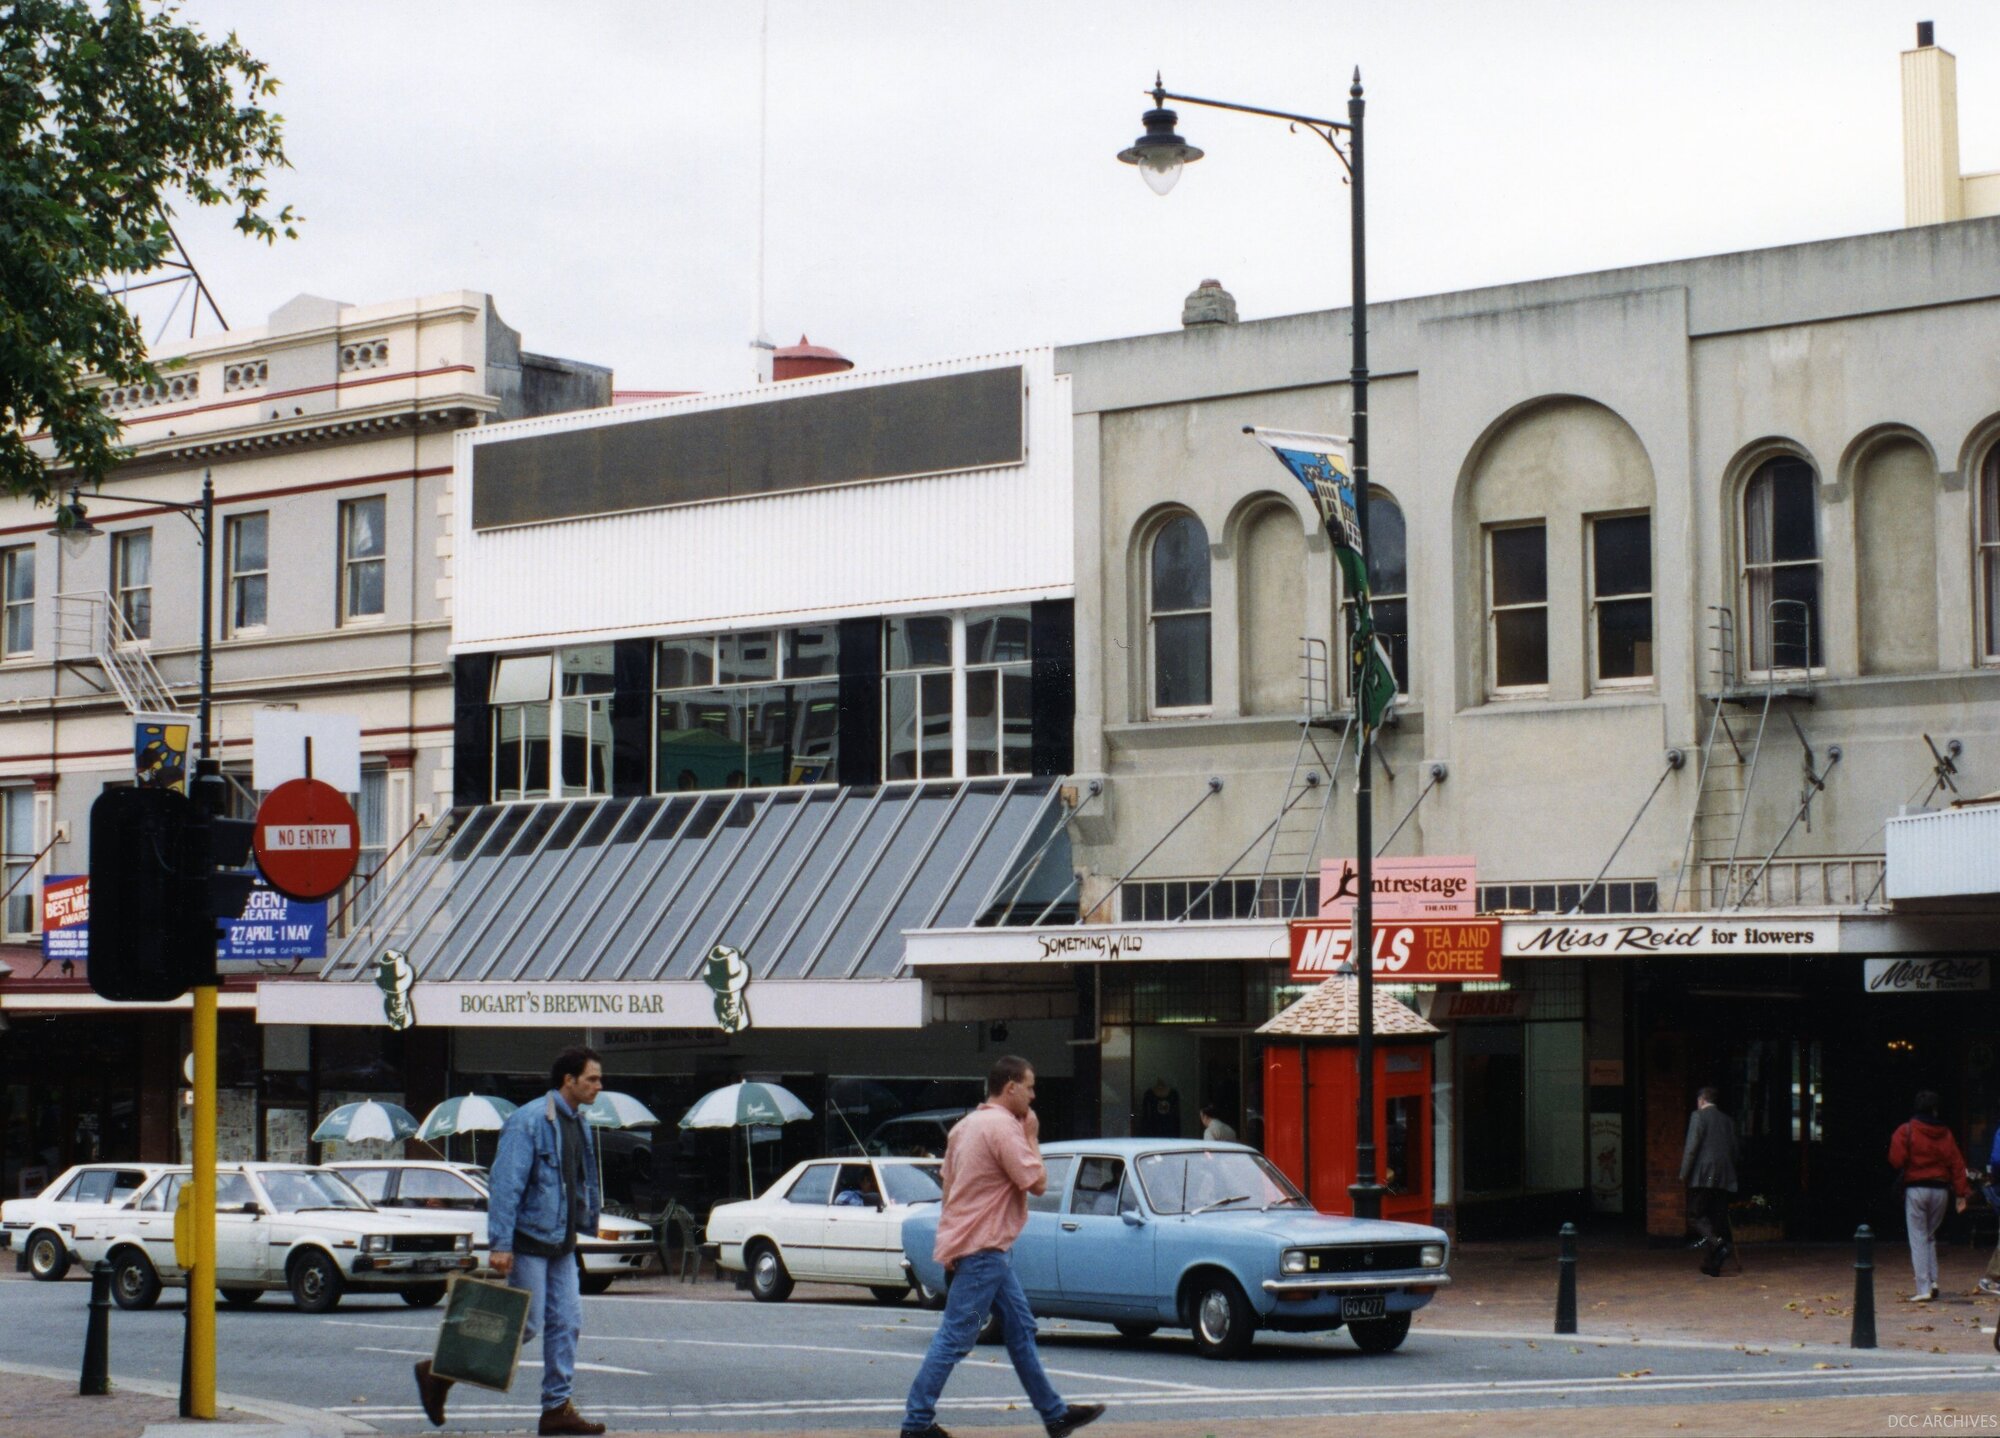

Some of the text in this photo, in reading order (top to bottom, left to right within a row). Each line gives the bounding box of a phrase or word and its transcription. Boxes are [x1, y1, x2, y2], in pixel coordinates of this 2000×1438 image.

[278, 829, 336, 845] NO ENTRY
[75, 884, 84, 894] OF
[45, 898, 70, 919] BEST
[236, 909, 287, 921] HEATRE
[1424, 904, 1458, 912] THEATRE
[231, 926, 245, 941] 27
[245, 925, 276, 941] APRIL
[281, 925, 286, 940] 1
[288, 925, 313, 940] MAY
[1423, 927, 1490, 948] TEA AND
[1517, 925, 1814, 952] Miss Reid for flowers
[1296, 928, 1415, 971] MELS
[1427, 950, 1484, 971] COFFEE
[1871, 960, 1926, 989] Miss
[460, 991, 664, 1013] BOGART'S BREWING BAR
